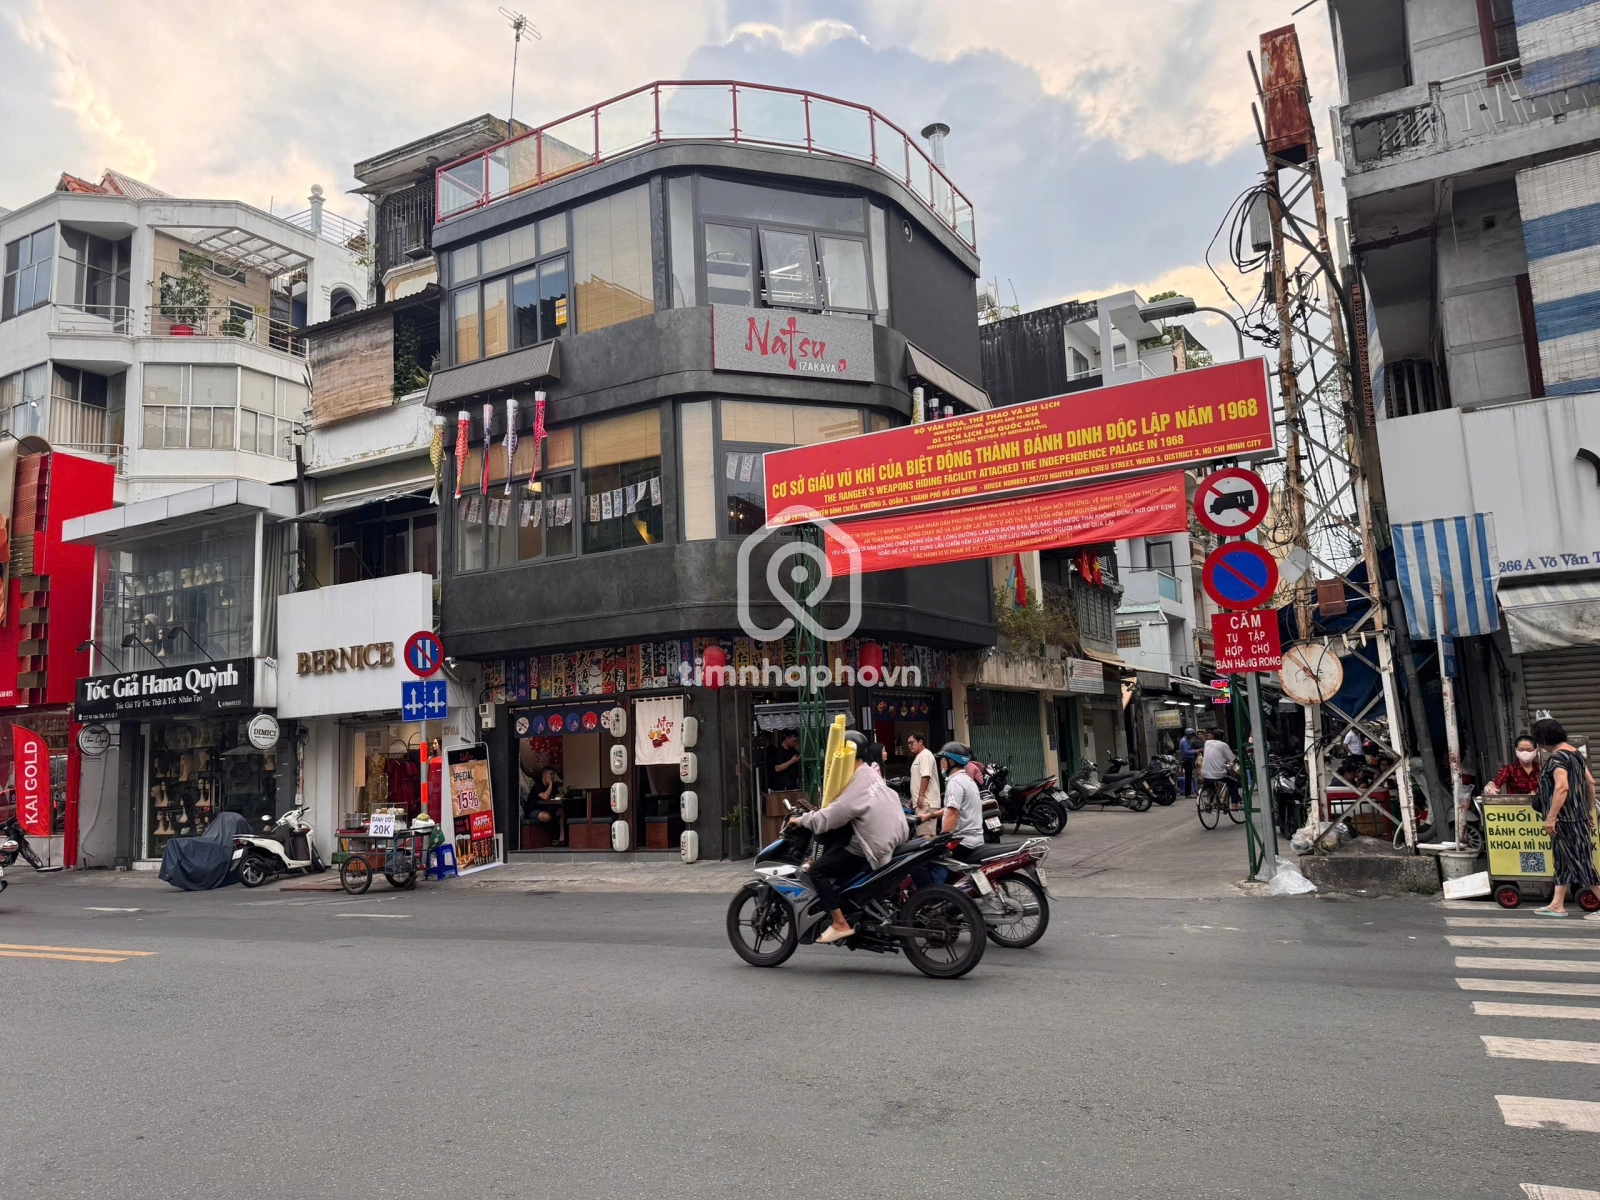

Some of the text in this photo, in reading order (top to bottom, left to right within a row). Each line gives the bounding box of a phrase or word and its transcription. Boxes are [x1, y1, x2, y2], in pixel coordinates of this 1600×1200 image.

[745, 316, 826, 370] Natsu
[800, 361, 837, 373] IZAKAYA
[986, 410, 1008, 420] THAO
[1025, 405, 1037, 413] DU
[933, 427, 954, 435] MINISTRY
[963, 422, 984, 430] CULTURE,
[1016, 411, 1038, 420] TOURISM
[1024, 418, 1040, 426] GIA
[926, 441, 952, 450] HISTORICAL
[954, 436, 975, 445] CULTURAL
[977, 432, 998, 440] VESTIGES
[1007, 426, 1032, 435] NATIONAL
[771, 397, 1257, 498] CƠ SỞ GIẤU VŨ KHÍ CỦA BIỆT ĐỘNG THÀNH ĐÁNH DINH ĐỘC LẬP NĂM 1968
[824, 434, 1184, 503] THE RANGER'S WEAPONS HIDING FACILITY ATTACKED THE INDEPENDENCE PALACE IN 1968
[950, 486, 960, 495] CHÍ
[961, 485, 977, 493] MINH
[983, 481, 1002, 489] HOUSE
[1003, 476, 1027, 486] NUMBER
[1028, 473, 1047, 482] 287/70
[1049, 469, 1073, 479] NGUYEN
[1091, 463, 1108, 472] CHIEU
[1110, 459, 1134, 470] STREET,
[1135, 456, 1155, 465] WARD
[1156, 454, 1162, 462] 5,
[1164, 449, 1193, 460] DISTRICT
[1194, 448, 1201, 456] 3,
[1202, 446, 1211, 454] HO
[1213, 444, 1224, 452] CHI
[1226, 441, 1244, 450] MINH
[1246, 438, 1261, 447] CITY
[1236, 494, 1246, 504] 1t
[1499, 560, 1522, 572] 266
[1524, 558, 1536, 570] A
[1539, 556, 1558, 568] Võ
[1560, 554, 1590, 566] Văn
[1230, 611, 1262, 630] CẤM
[1226, 630, 1266, 644] TỤ TẬP
[1225, 642, 1270, 656] HỢP CHỢ
[296, 641, 395, 676] BERNICE
[1216, 655, 1282, 670] BÁN HÀNG RONG
[85, 664, 239, 701] Tóc Giả Hana Quỳnh
[116, 702, 124, 710] Tóc
[142, 700, 150, 708] Tóc
[168, 696, 176, 704] Tóc
[254, 728, 277, 736] DIMICI
[24, 741, 38, 824] KAI GOLD
[454, 771, 474, 782] SPECIAL
[456, 792, 480, 810] 15%
[1486, 809, 1531, 822] CHUỐI
[373, 824, 390, 835] 20K
[1488, 826, 1516, 836] BÁNH
[1490, 838, 1552, 850] KHOAI MÌ NU
